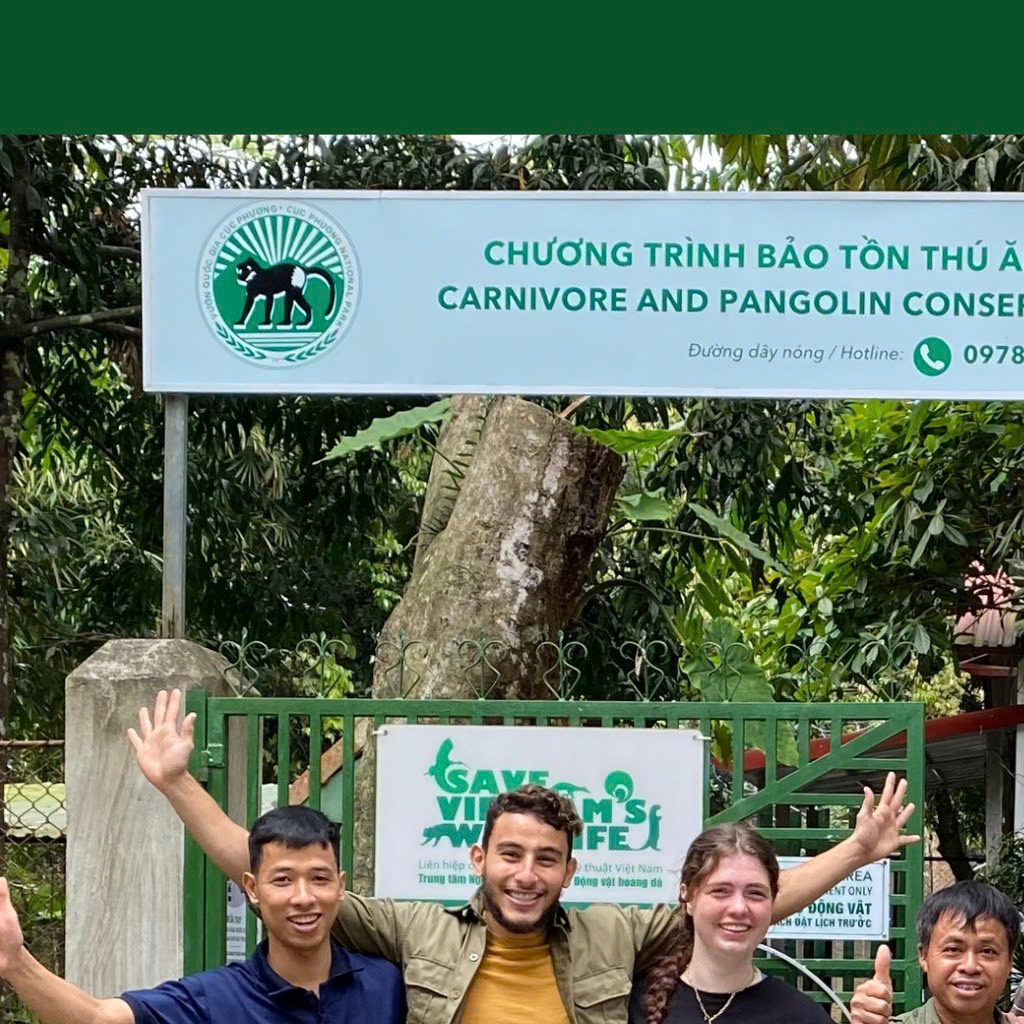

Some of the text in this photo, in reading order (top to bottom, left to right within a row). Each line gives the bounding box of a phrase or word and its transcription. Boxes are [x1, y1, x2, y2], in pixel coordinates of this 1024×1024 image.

[484, 236, 633, 267] CHƯƠNG
[643, 236, 745, 268] TRÌNH
[757, 236, 829, 270] BẢO
[839, 235, 909, 270] TỒN
[920, 240, 988, 272] THÚ
[339, 246, 355, 294] NATIONAL
[438, 285, 627, 312] CARNIVORE
[636, 288, 708, 313] AND
[720, 289, 891, 316] PANGOLIN
[335, 295, 355, 328] PARK
[688, 343, 743, 362] Đường
[748, 344, 778, 362] dây
[783, 345, 824, 363] nóng
[828, 345, 837, 361] /
[840, 345, 904, 361] Hotline:
[963, 344, 1024, 364] 0978
[418, 859, 440, 870] Liên
[443, 859, 465, 872] hiệp
[615, 863, 635, 874] Việt
[638, 864, 663, 874] Nam
[418, 873, 445, 885] Trung
[448, 874, 466, 884] tâm
[618, 877, 648, 888] hoang
[846, 870, 873, 882] REA
[848, 886, 873, 896] ONLY
[808, 899, 872, 918] ĐỘNG VẬT
[815, 918, 835, 929] LỊCH
